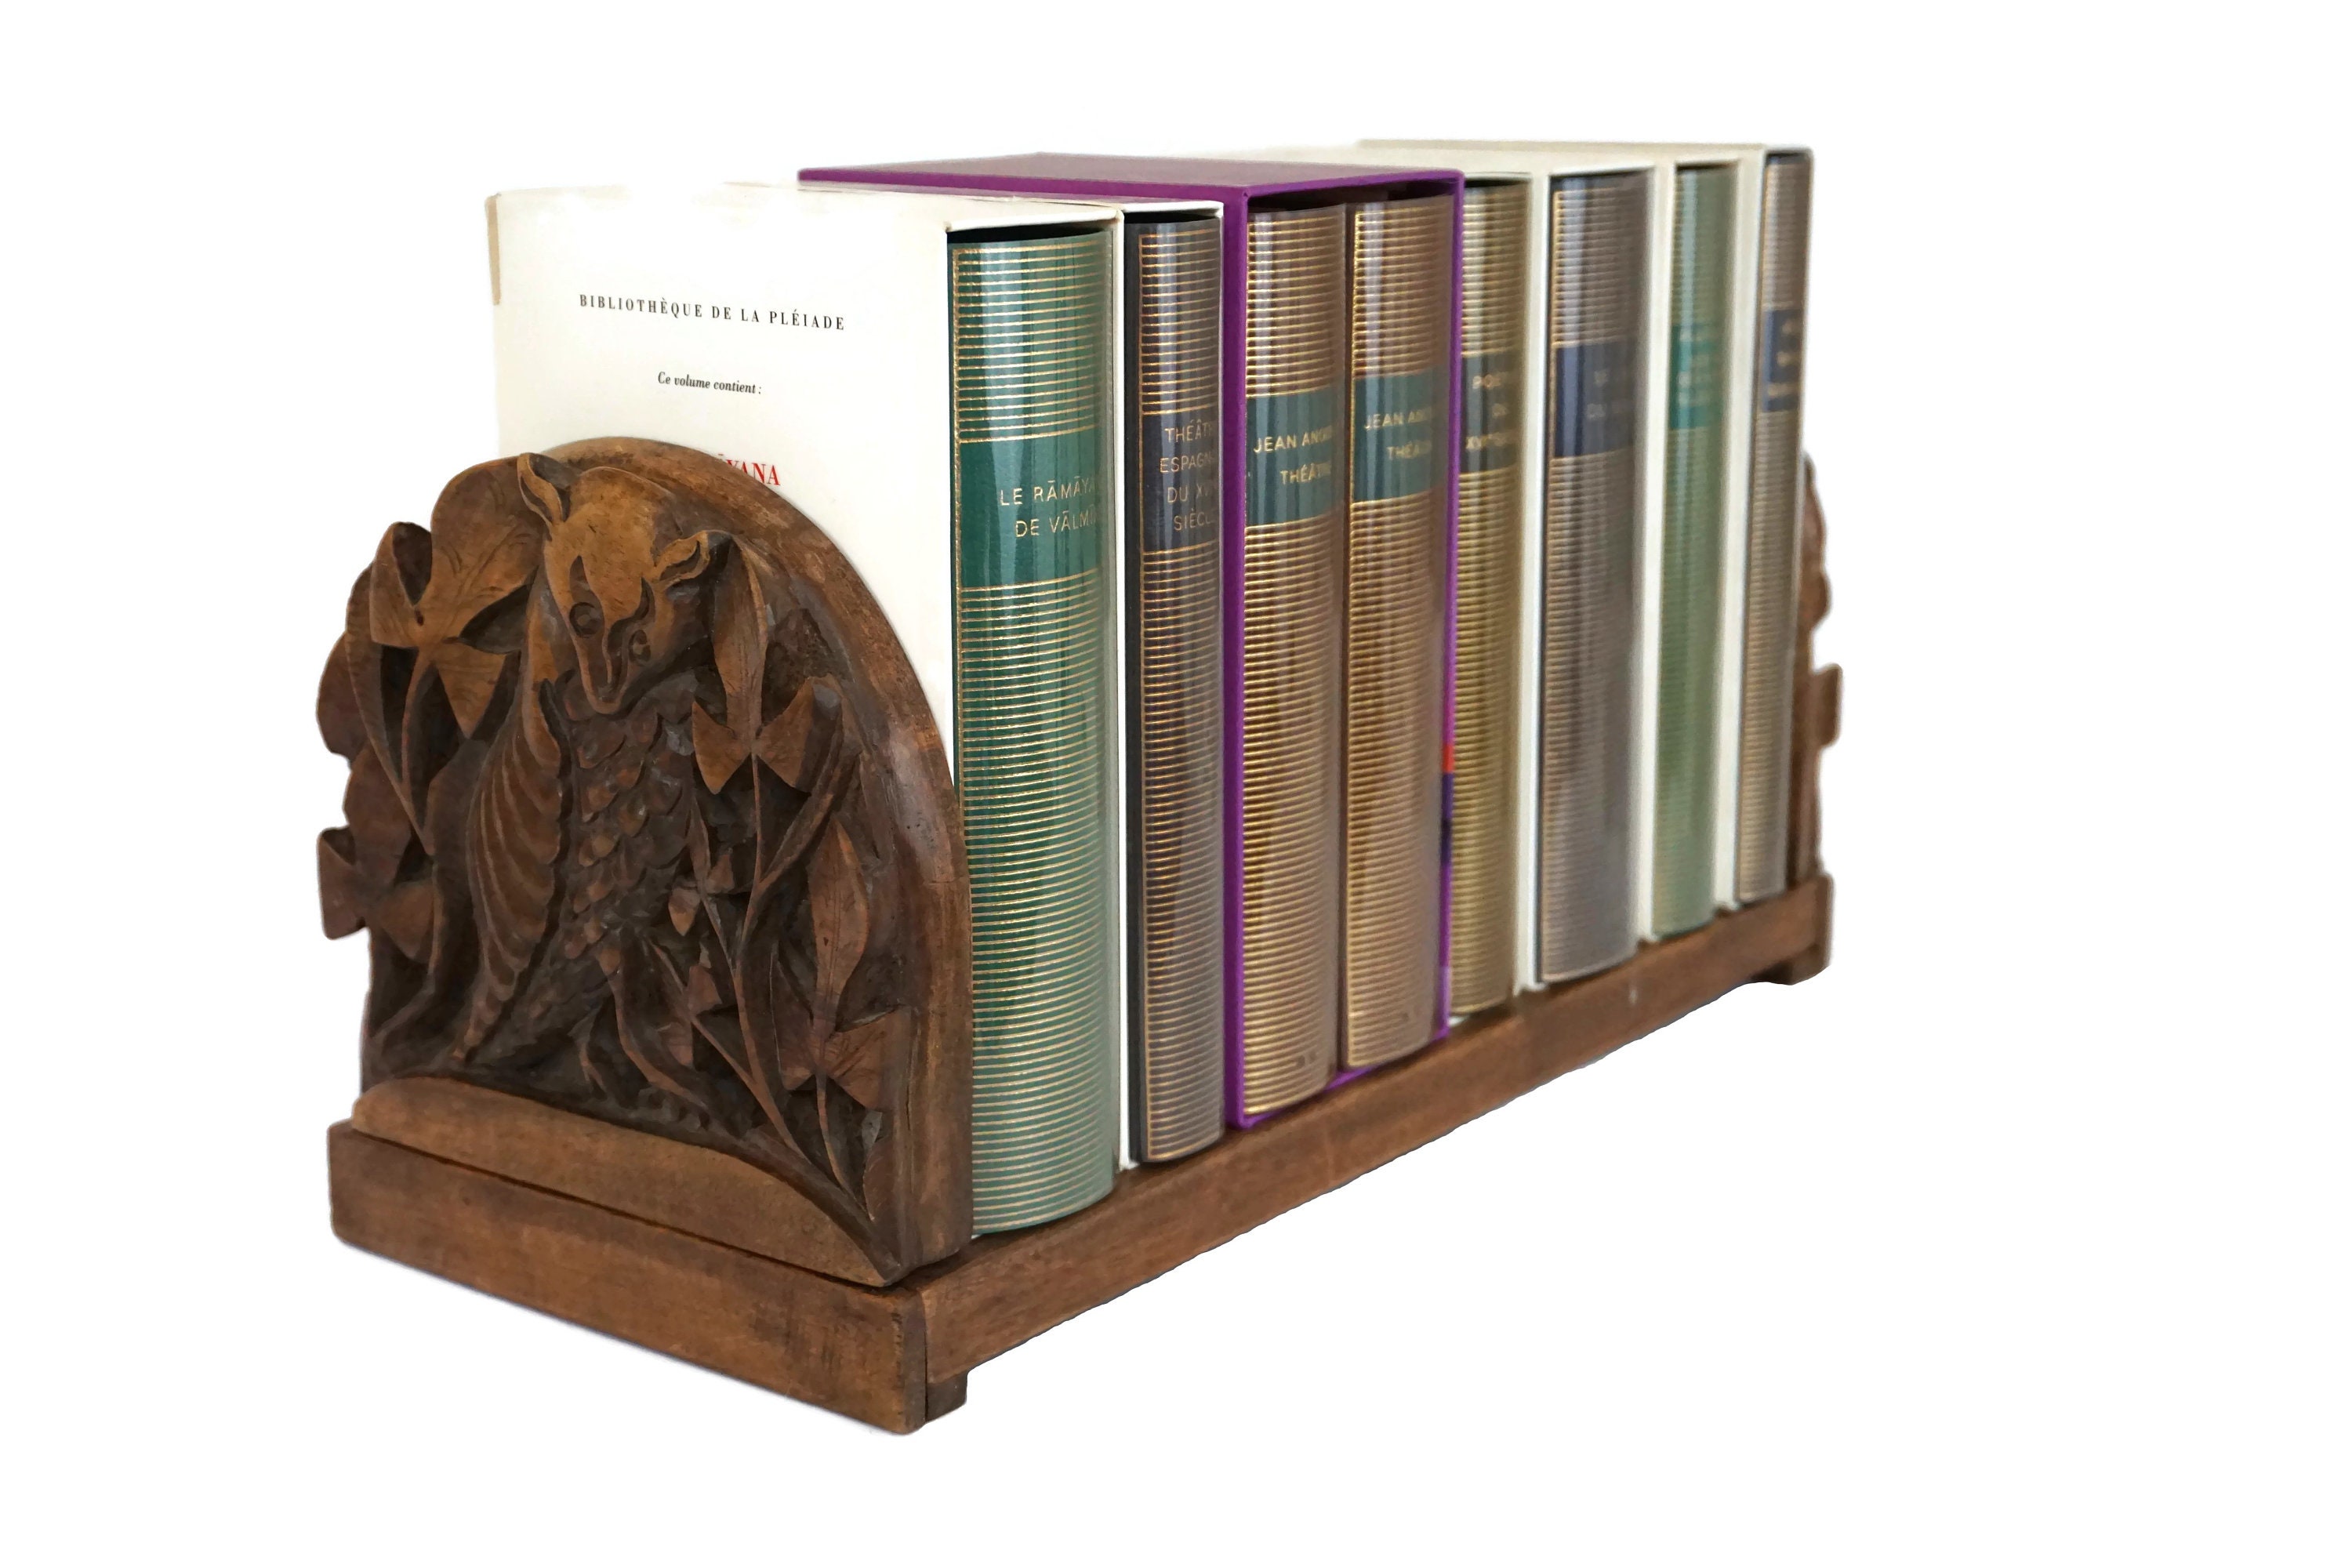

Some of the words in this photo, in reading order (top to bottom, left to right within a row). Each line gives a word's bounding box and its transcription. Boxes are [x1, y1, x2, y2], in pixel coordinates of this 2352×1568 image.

[579, 294, 702, 318] BIBLIOTHÈQUE
[711, 305, 731, 320] DE
[741, 308, 760, 323] LA
[769, 309, 844, 331] PLÉIADE
[658, 371, 671, 384] Ce
[674, 374, 710, 389] volume
[713, 380, 756, 394] contient
[1365, 413, 1404, 430] JEAN
[1254, 433, 1298, 453] JEAN
[1000, 488, 1023, 506] LE
[1167, 485, 1189, 503] DU
[1015, 518, 1040, 538] DE
[1174, 508, 1214, 532] SIÈCL
